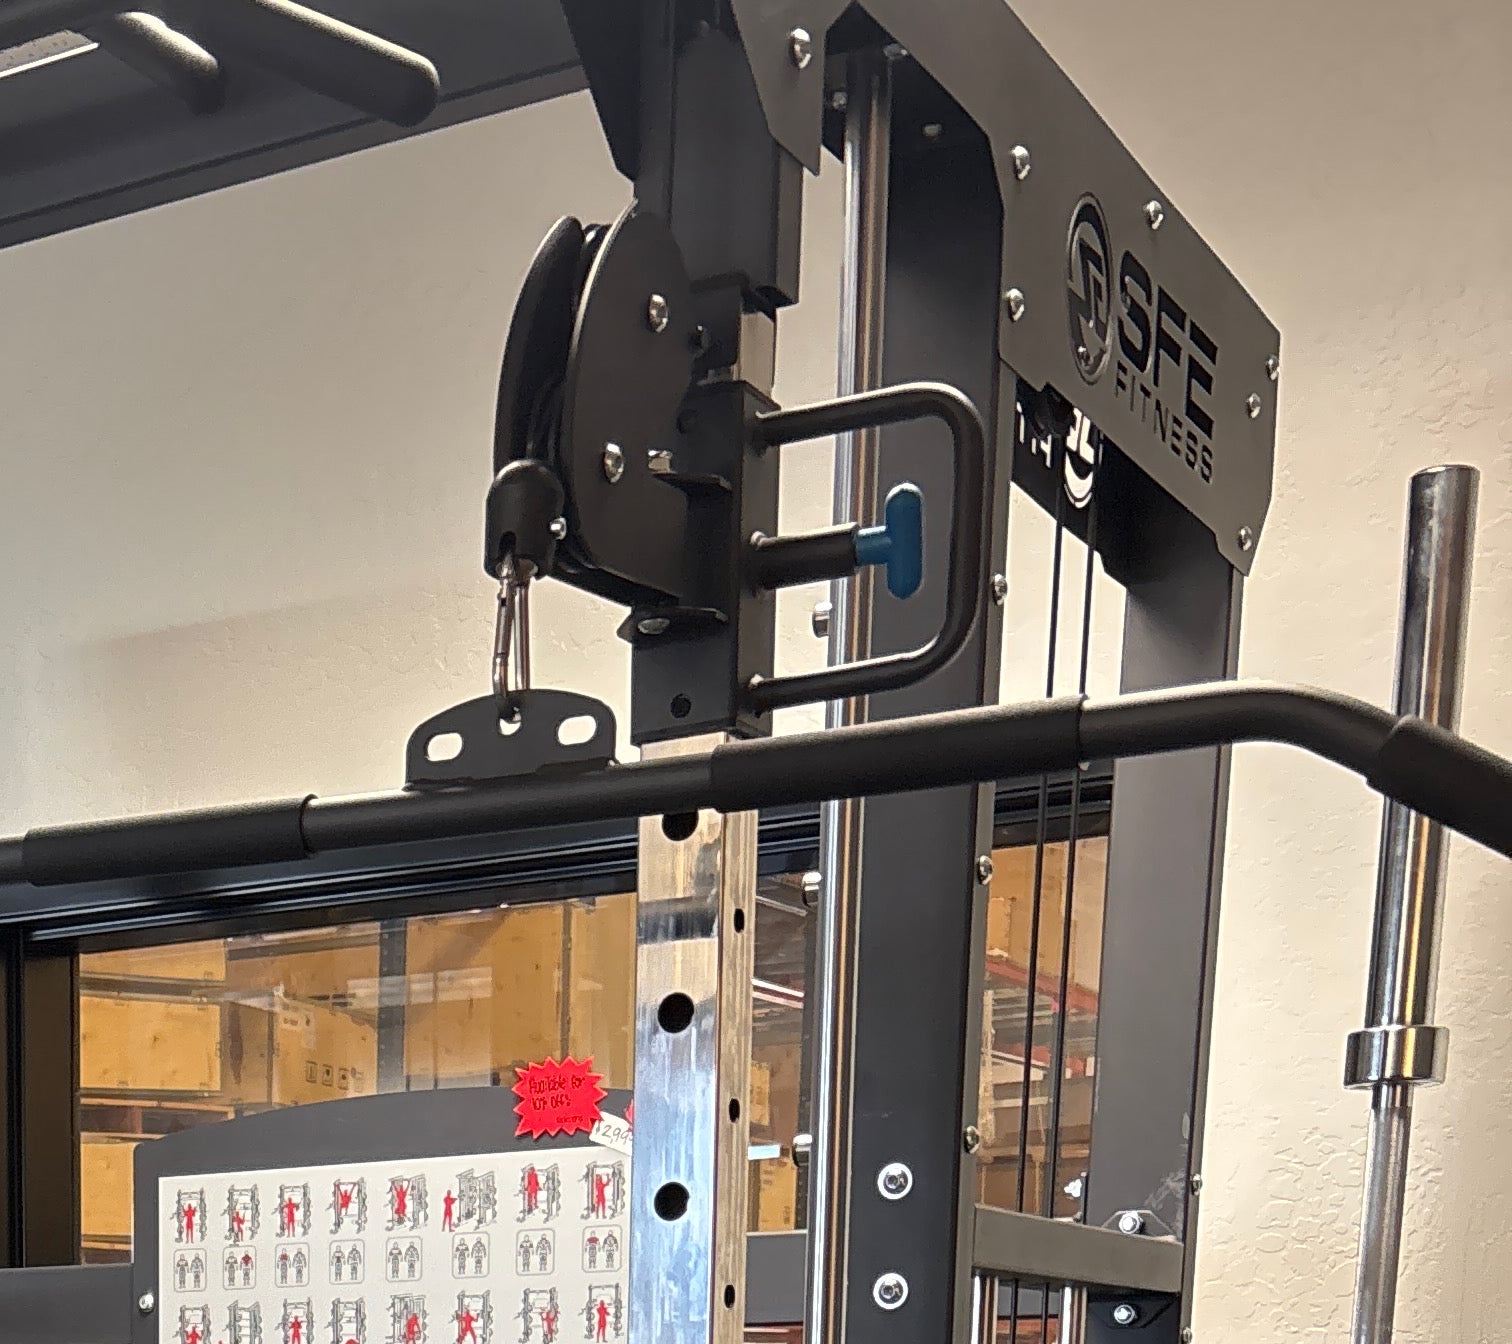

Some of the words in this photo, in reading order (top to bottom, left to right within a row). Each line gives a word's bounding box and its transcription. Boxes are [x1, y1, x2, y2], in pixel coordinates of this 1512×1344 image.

[1117, 249, 1219, 441] SFE
[1115, 359, 1213, 484] FITNESS
[595, 1119, 634, 1147] $2,99
